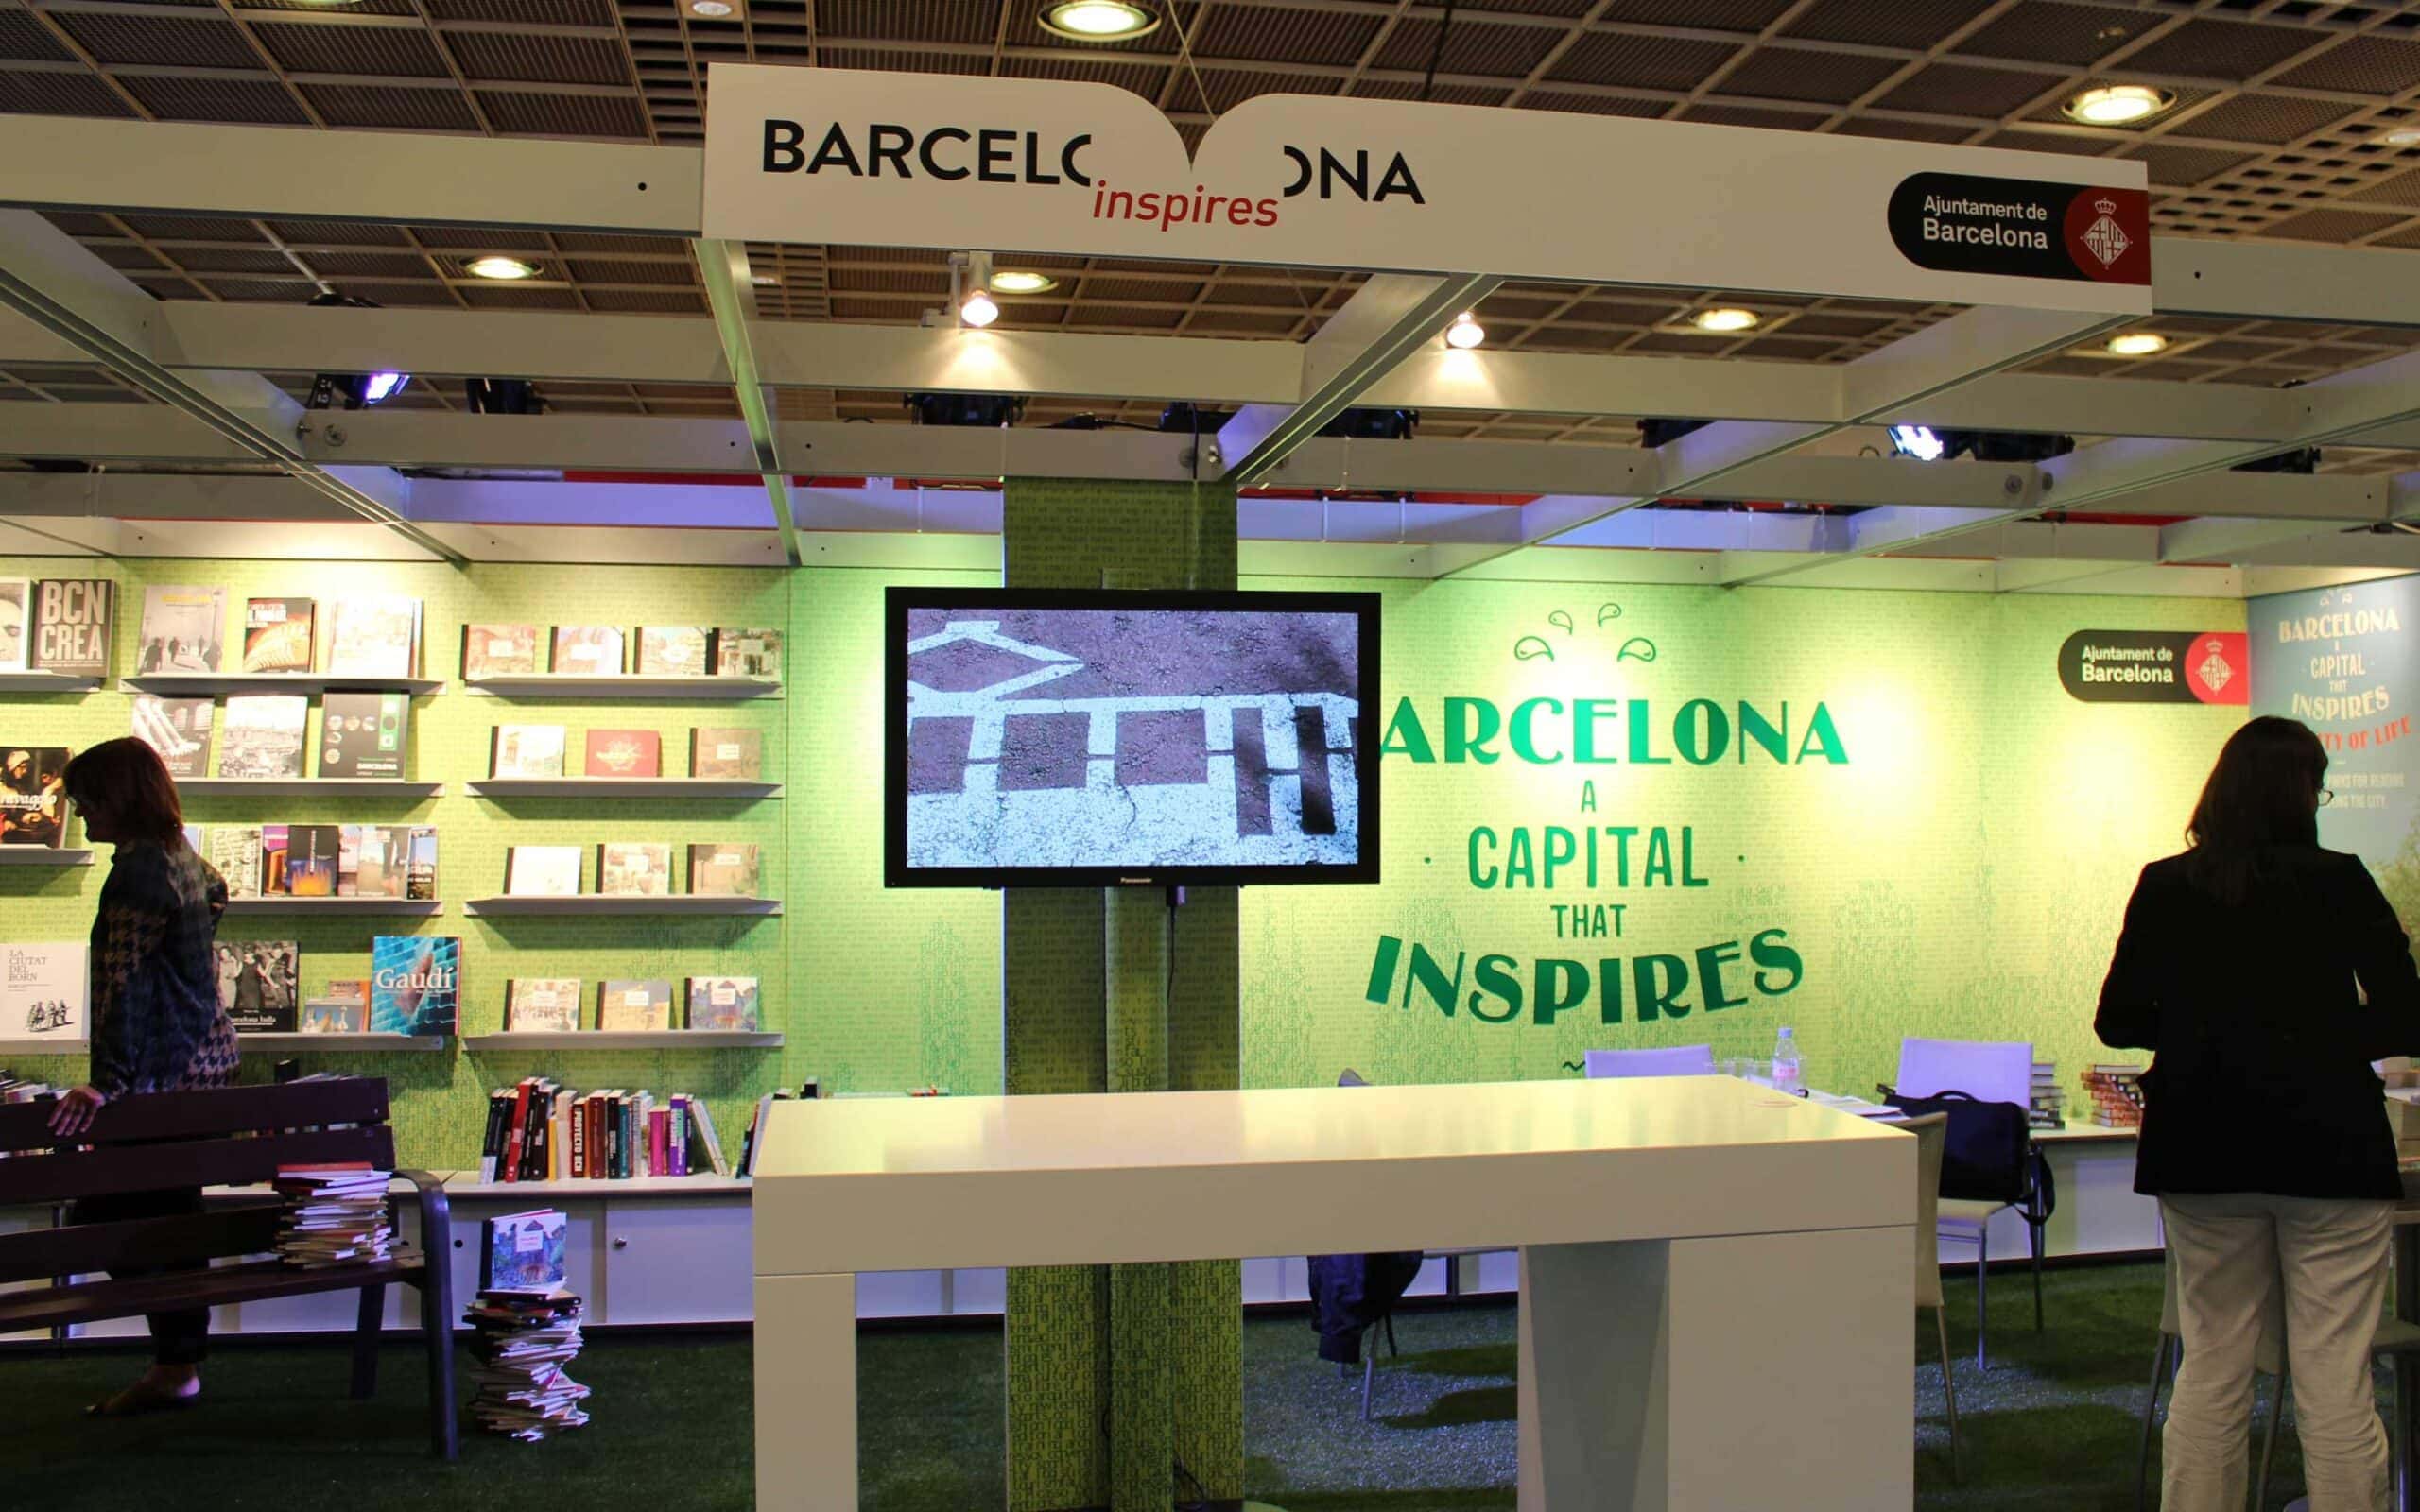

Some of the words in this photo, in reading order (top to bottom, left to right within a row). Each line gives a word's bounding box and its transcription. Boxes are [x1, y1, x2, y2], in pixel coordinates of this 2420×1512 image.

[1094, 180, 1279, 232] inspires
[1923, 195, 2024, 218] Ajuntament
[2026, 203, 2048, 220] de
[1923, 217, 2048, 249] Barcelona
[42, 581, 107, 624] BCN
[2279, 606, 2401, 644] BARCELONA
[39, 625, 105, 660] CREA
[2082, 644, 2155, 662] Ajuntament
[2156, 648, 2173, 662] de
[2082, 662, 2174, 683] Barcelona
[2310, 652, 2366, 679] CAPITAL
[2291, 685, 2390, 721] INSPIRES
[1381, 696, 1849, 765] ARCELONA
[1581, 780, 1597, 813] A
[1468, 826, 1709, 890] CAPITAL
[1550, 904, 1626, 938] THAT
[376, 966, 454, 989] Gaudí
[1366, 928, 1803, 1025] INSPIRES
